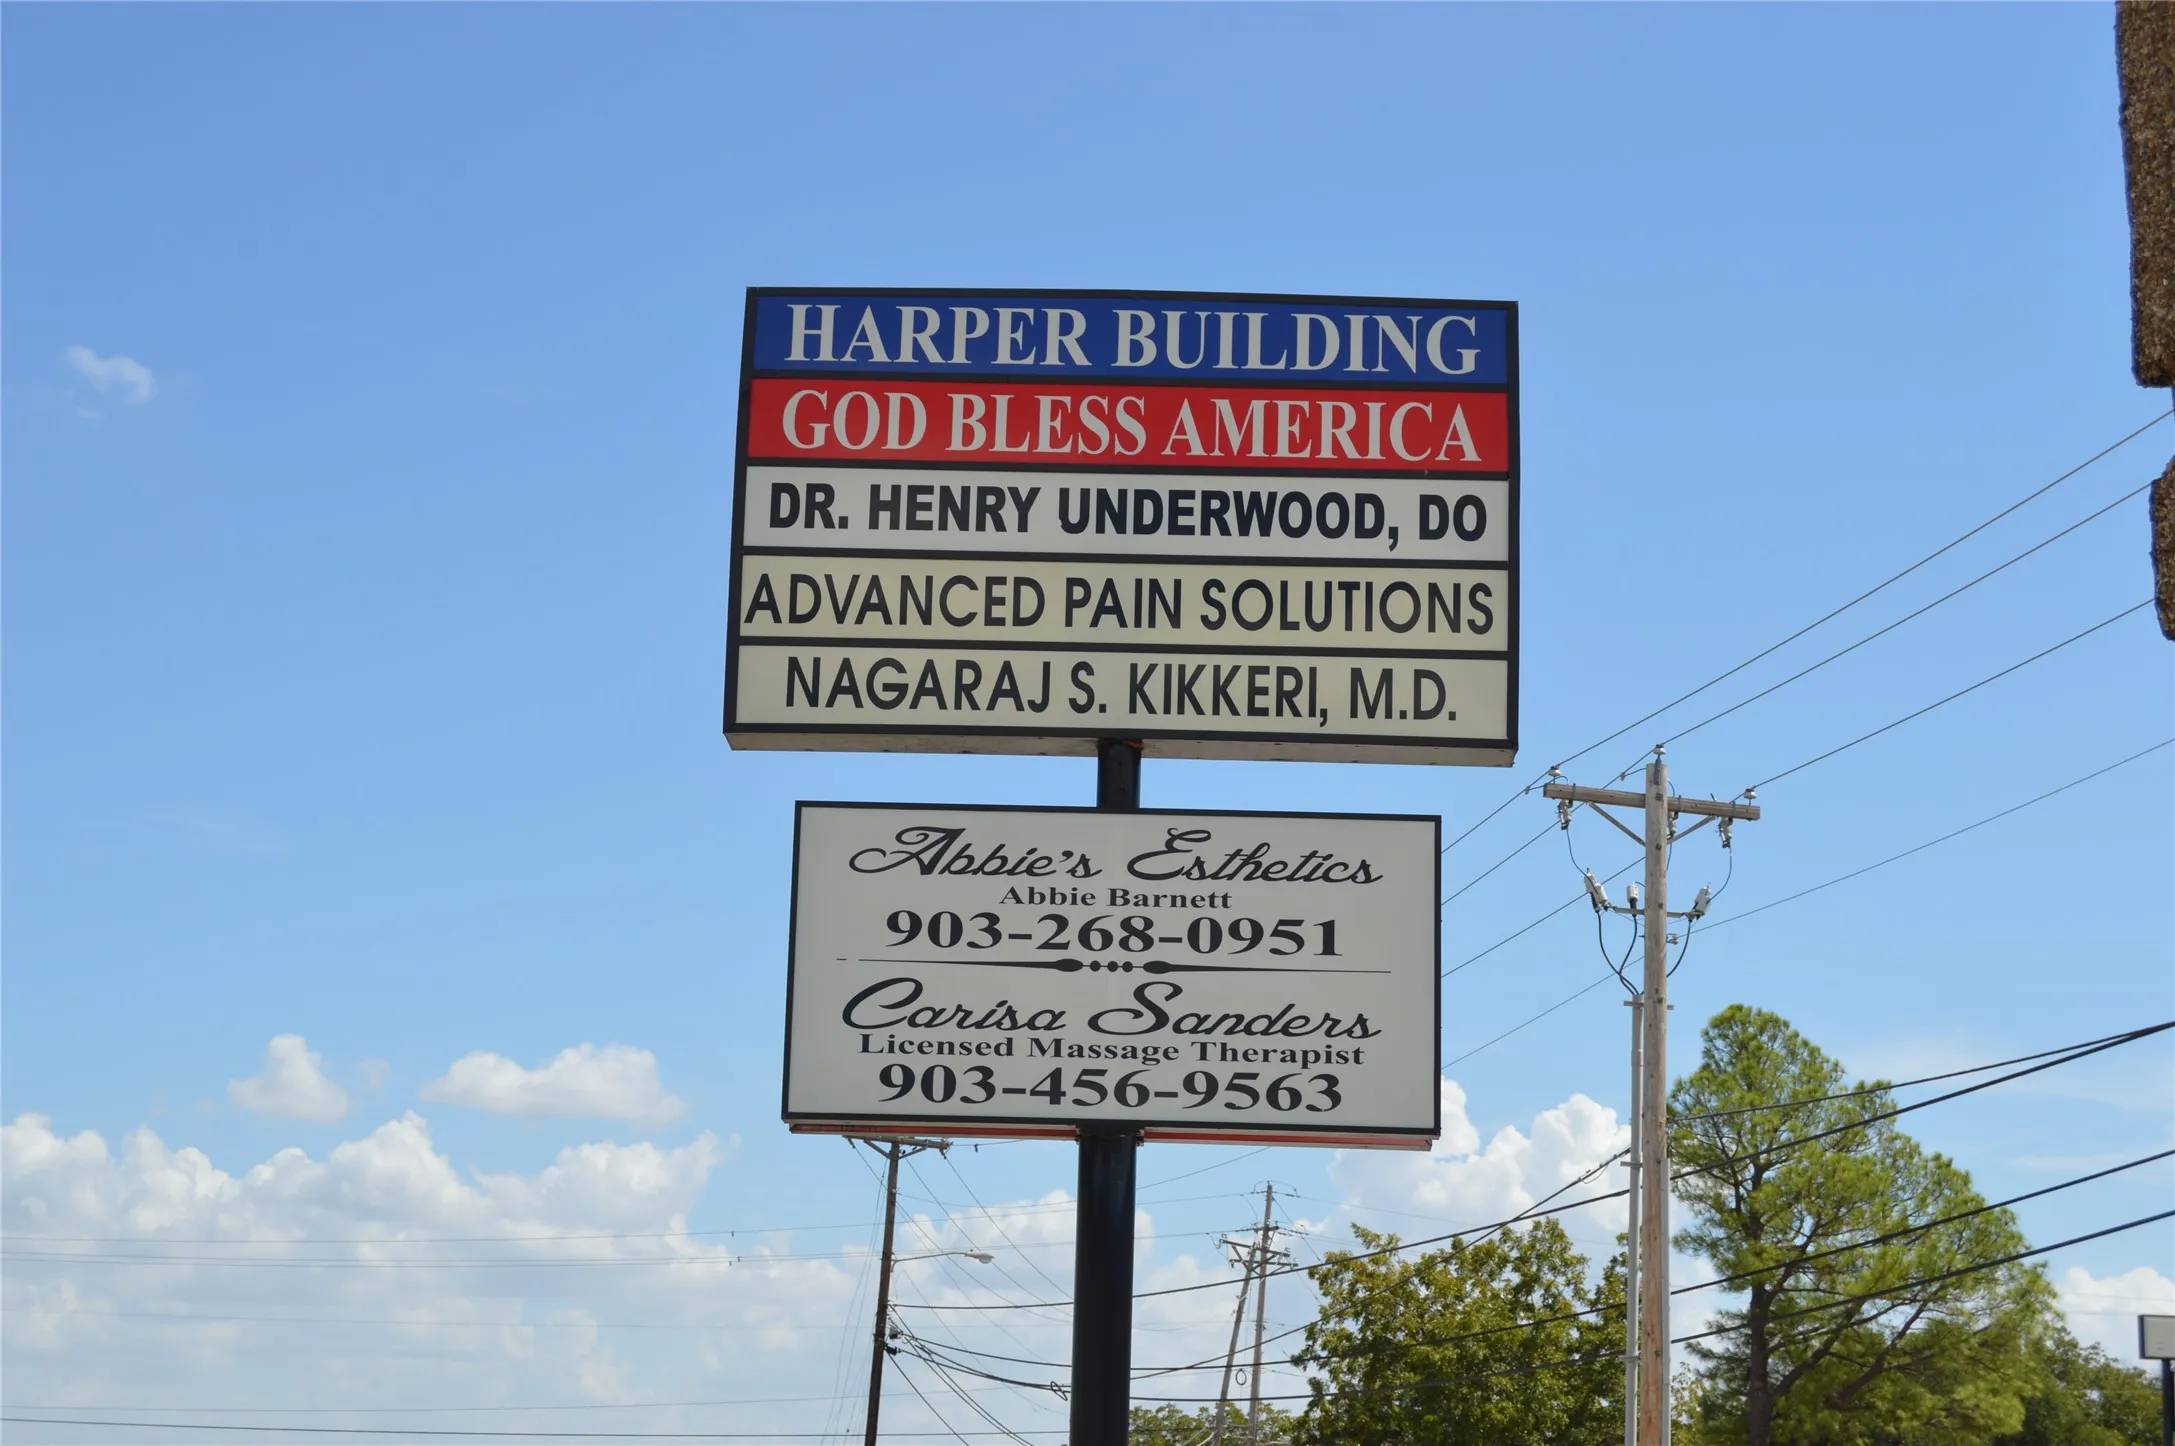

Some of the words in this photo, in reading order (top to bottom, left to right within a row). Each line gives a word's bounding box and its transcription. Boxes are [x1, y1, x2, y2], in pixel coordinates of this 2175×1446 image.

[784, 304, 1093, 366] HARPER
[1110, 309, 1481, 375] BUILDING
[782, 389, 927, 450] GOD
[945, 393, 1147, 456] BLESS
[1161, 398, 1482, 462] AMERICA
[769, 482, 849, 530] DR.
[868, 483, 1042, 533] HENRY
[1058, 487, 1399, 552] UNDERWOOD,
[1418, 494, 1487, 542] DO
[743, 573, 1046, 628] ADVANCED
[1064, 577, 1182, 629] PAIN
[1200, 578, 1494, 636] SOLUTIONS
[785, 656, 1051, 714] NAGARAJ
[1068, 660, 1107, 714] S.
[1128, 662, 1328, 728] KIKKERI,
[1349, 667, 1457, 721] M.D.
[848, 825, 1103, 879] Abbie's
[1126, 827, 1384, 885] Esthetics
[999, 886, 1096, 907] Abbie
[1107, 888, 1232, 909] Barnett
[886, 909, 1342, 957] 903-268-0951
[841, 977, 1067, 1032] Carisa
[1087, 981, 1382, 1040] Sanders
[859, 1033, 1014, 1057] Licensed
[1028, 1037, 1180, 1066] Massage
[1190, 1041, 1365, 1070] Therapist
[878, 1063, 1342, 1113] 903-456-9563
